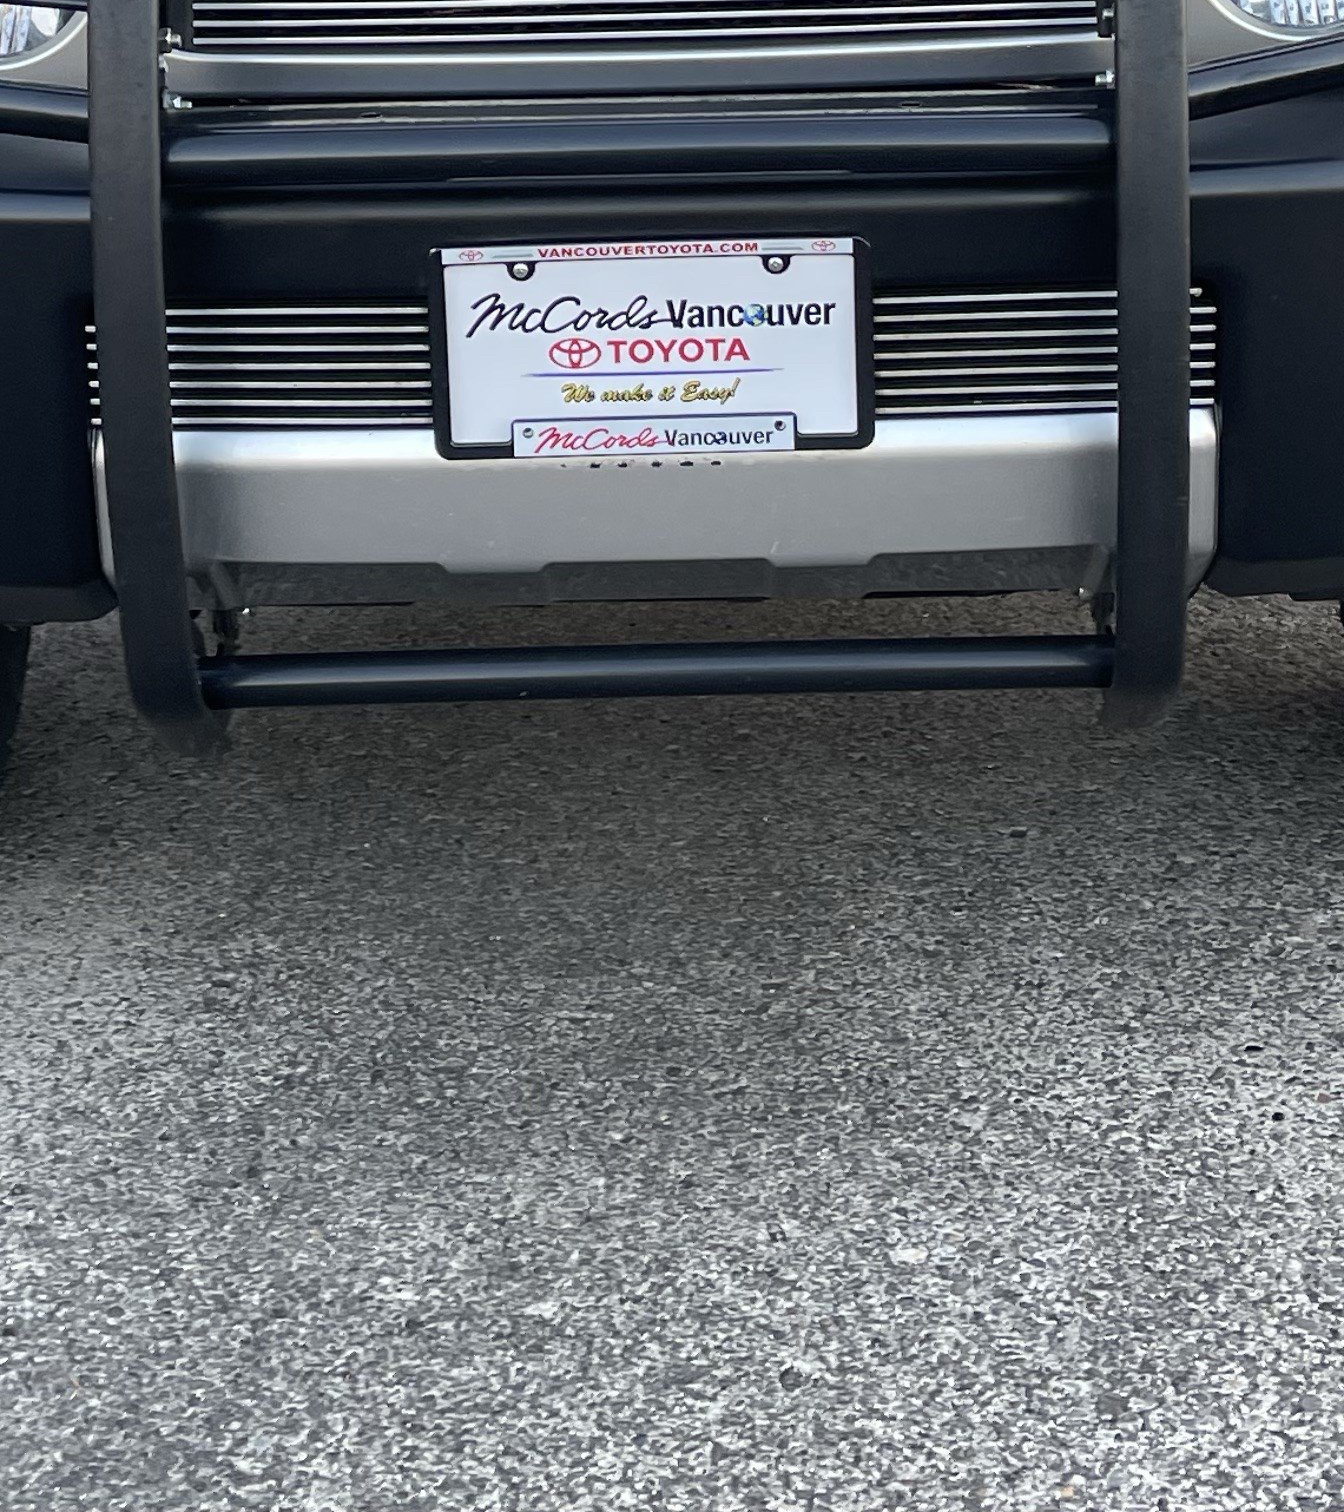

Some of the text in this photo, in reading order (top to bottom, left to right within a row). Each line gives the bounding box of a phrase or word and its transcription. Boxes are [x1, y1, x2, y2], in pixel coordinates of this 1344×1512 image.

[537, 241, 759, 258] VANCOUVERTOYOTA.COM
[465, 292, 837, 339] McCords Vancouver
[606, 337, 751, 364] TOYOTA
[560, 376, 741, 404] We make it Easy!
[533, 426, 775, 454] McCords Vancouver
